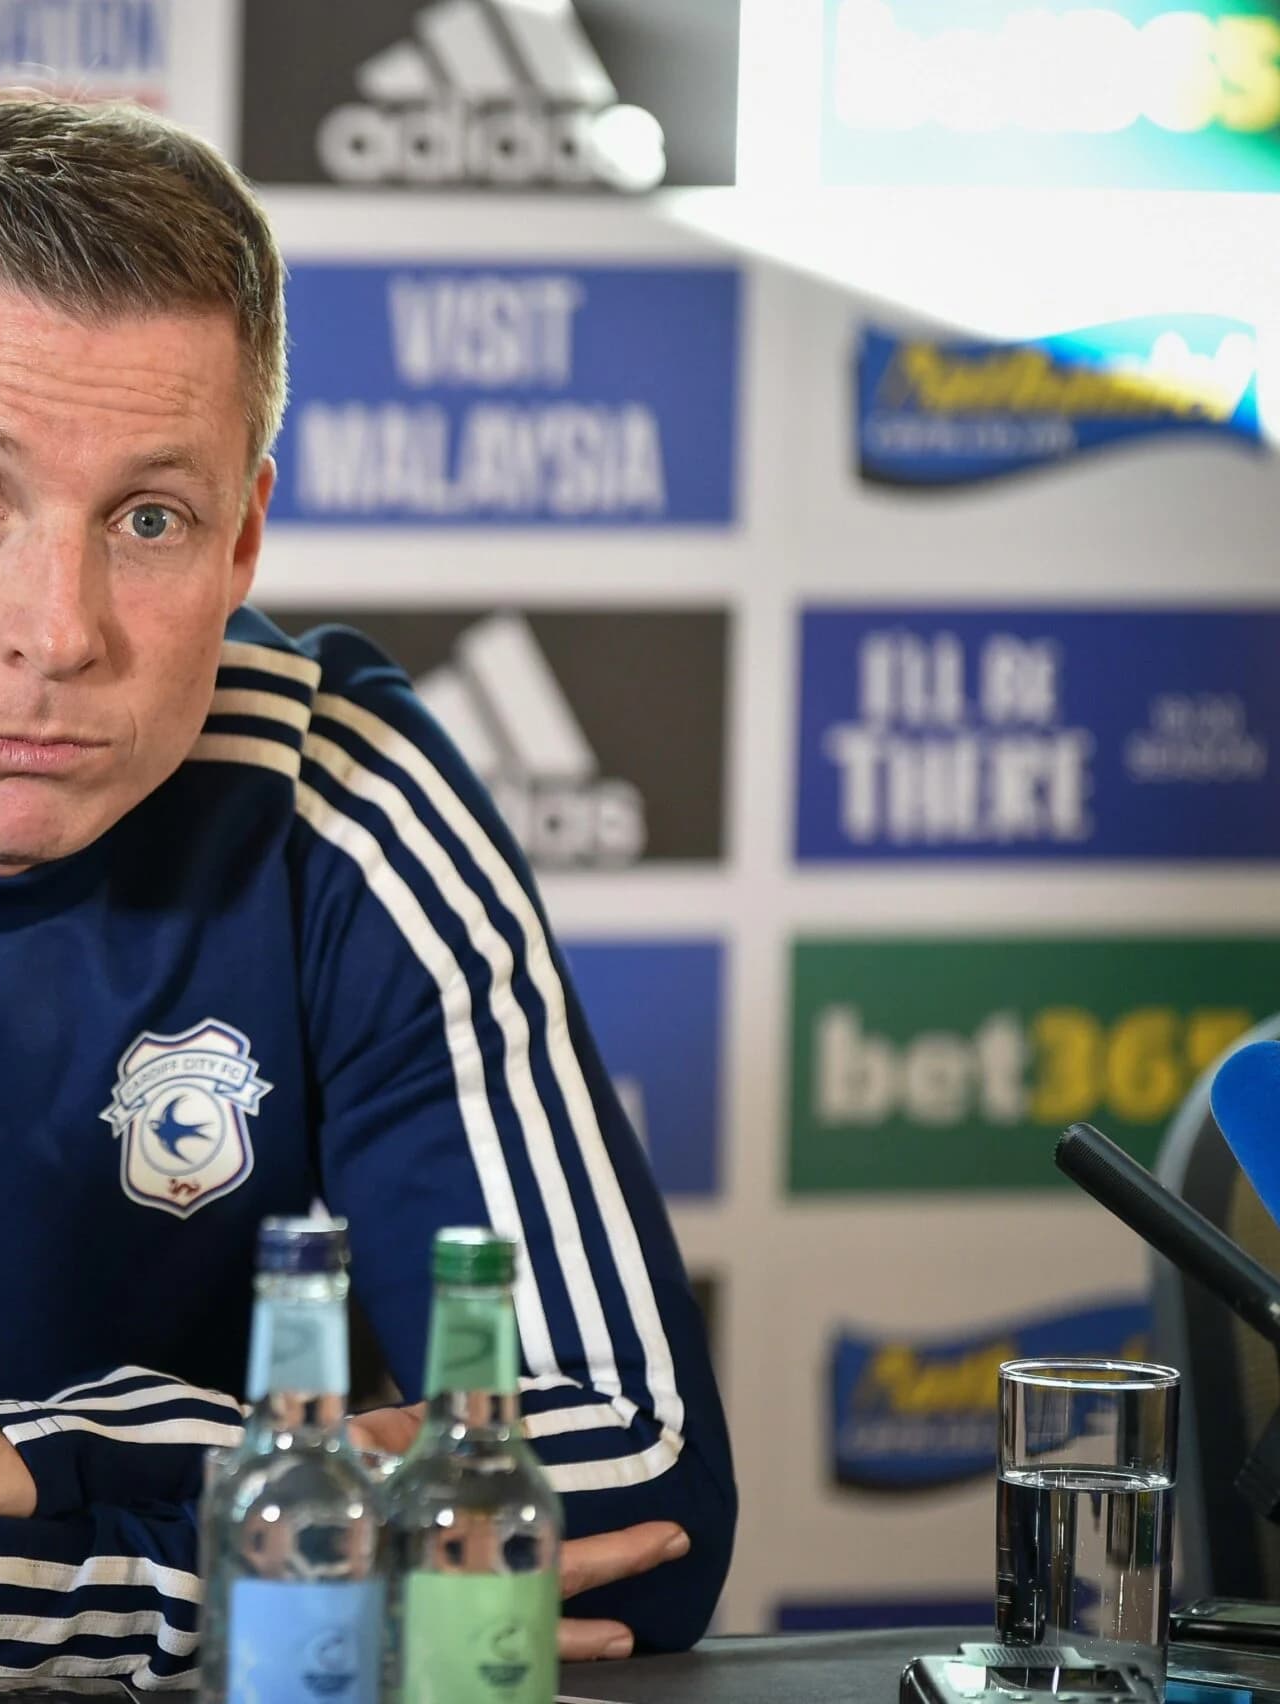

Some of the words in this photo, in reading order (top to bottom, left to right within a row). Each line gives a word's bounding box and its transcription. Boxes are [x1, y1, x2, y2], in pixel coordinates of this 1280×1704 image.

[389, 280, 584, 388] VISIT
[297, 405, 667, 516] MALAYSIA
[824, 725, 1095, 844] THERE
